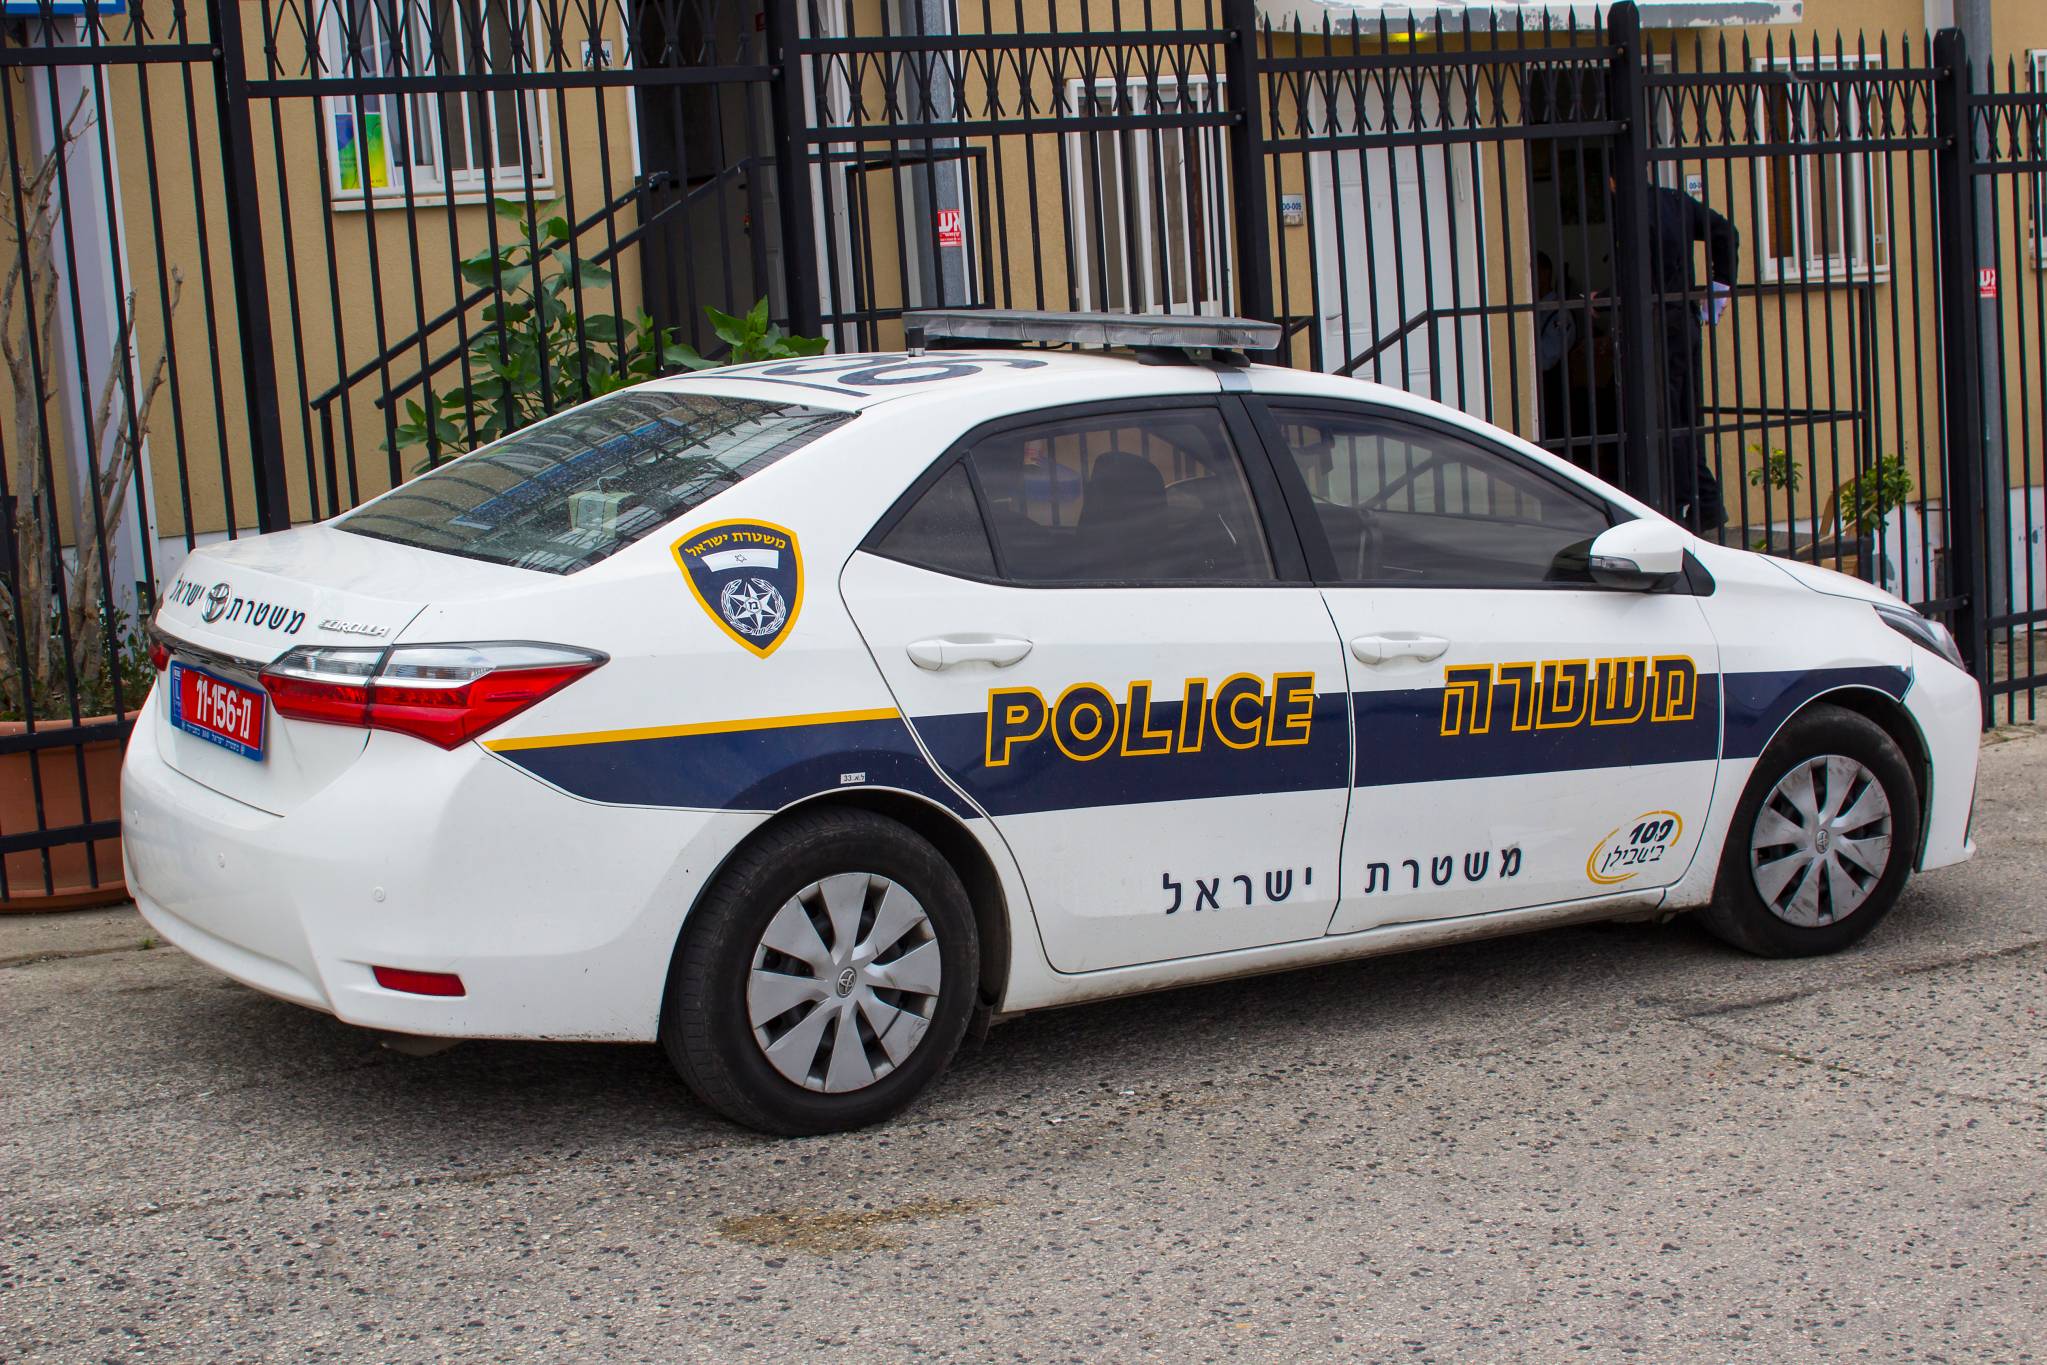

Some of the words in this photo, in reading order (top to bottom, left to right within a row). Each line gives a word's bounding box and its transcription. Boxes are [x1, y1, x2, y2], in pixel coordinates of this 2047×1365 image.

[684, 533, 729, 557] ישראל
[731, 531, 787, 549] משטרת
[169, 573, 206, 607] ישראל
[226, 597, 306, 634] משטרת
[319, 617, 392, 638] COROLLA
[1440, 654, 1698, 737] משטרה
[985, 671, 1316, 768] POLICE
[1364, 847, 1522, 894] משטרת
[1162, 866, 1313, 915] ישראל
